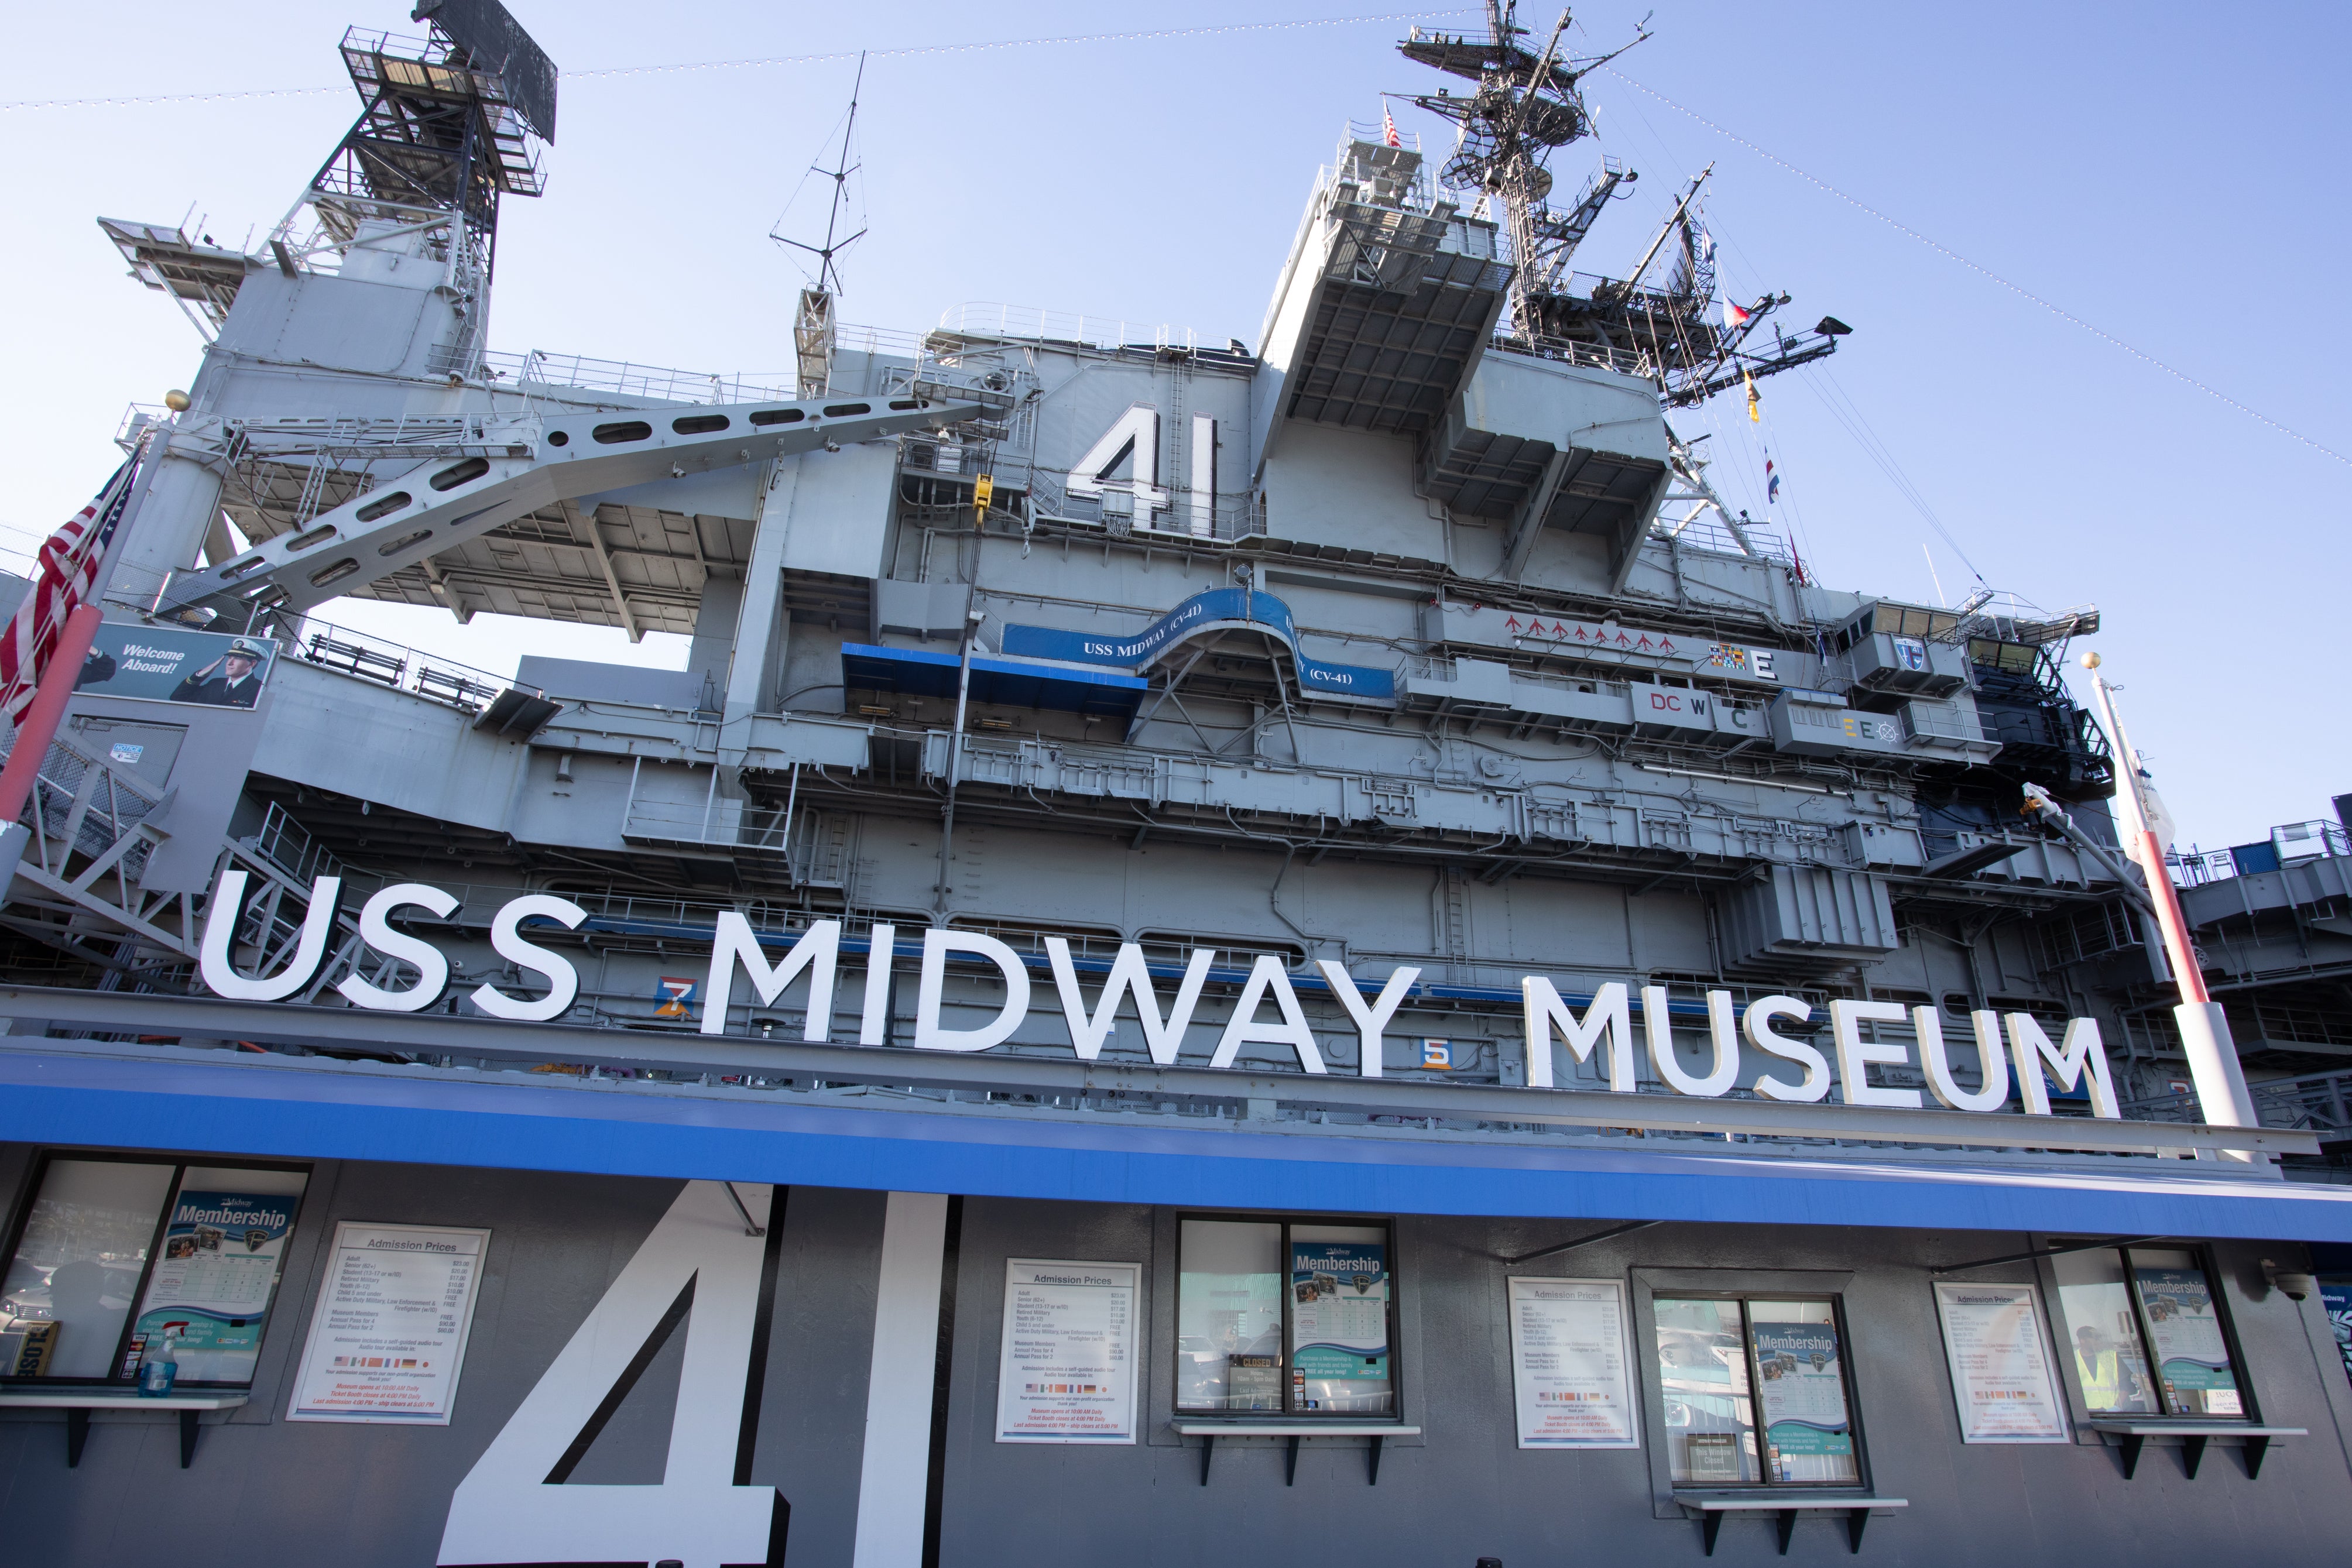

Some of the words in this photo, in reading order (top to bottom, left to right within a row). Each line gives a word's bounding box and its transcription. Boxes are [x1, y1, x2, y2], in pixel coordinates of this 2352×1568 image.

[1067, 400, 1214, 538] 41
[1084, 642, 1112, 656] USS
[1117, 626, 1166, 657] MIDWAY
[1170, 603, 1202, 631] (CV-41)
[123, 644, 185, 661] Welcome
[121, 658, 178, 674] Aboard!
[1750, 650, 1777, 680] E
[1310, 668, 1352, 685] (CV-41)
[1650, 692, 1681, 712] DC
[1691, 698, 1705, 715] W
[1732, 708, 1747, 729] C
[1843, 718, 1857, 737] E
[1859, 720, 1874, 739] E
[200, 869, 591, 1023] USS
[700, 911, 1422, 1078] MIDWAY
[1521, 975, 2121, 1118] MUSEUM
[663, 982, 692, 1011] 7
[1424, 1038, 1449, 1064] 5
[177, 1205, 286, 1230] Membership
[367, 1238, 422, 1250] Admission
[425, 1242, 457, 1252] Prices
[1297, 1255, 1380, 1275] Membership
[1034, 1274, 1081, 1284] Admission
[1084, 1276, 1112, 1285] Prices
[2142, 1280, 2207, 1296] Membership
[1534, 1291, 1575, 1299] Admission
[1759, 1335, 1832, 1353] Membership
[1243, 1358, 1270, 1367] CLOSED
[436, 1179, 951, 1568] 41
